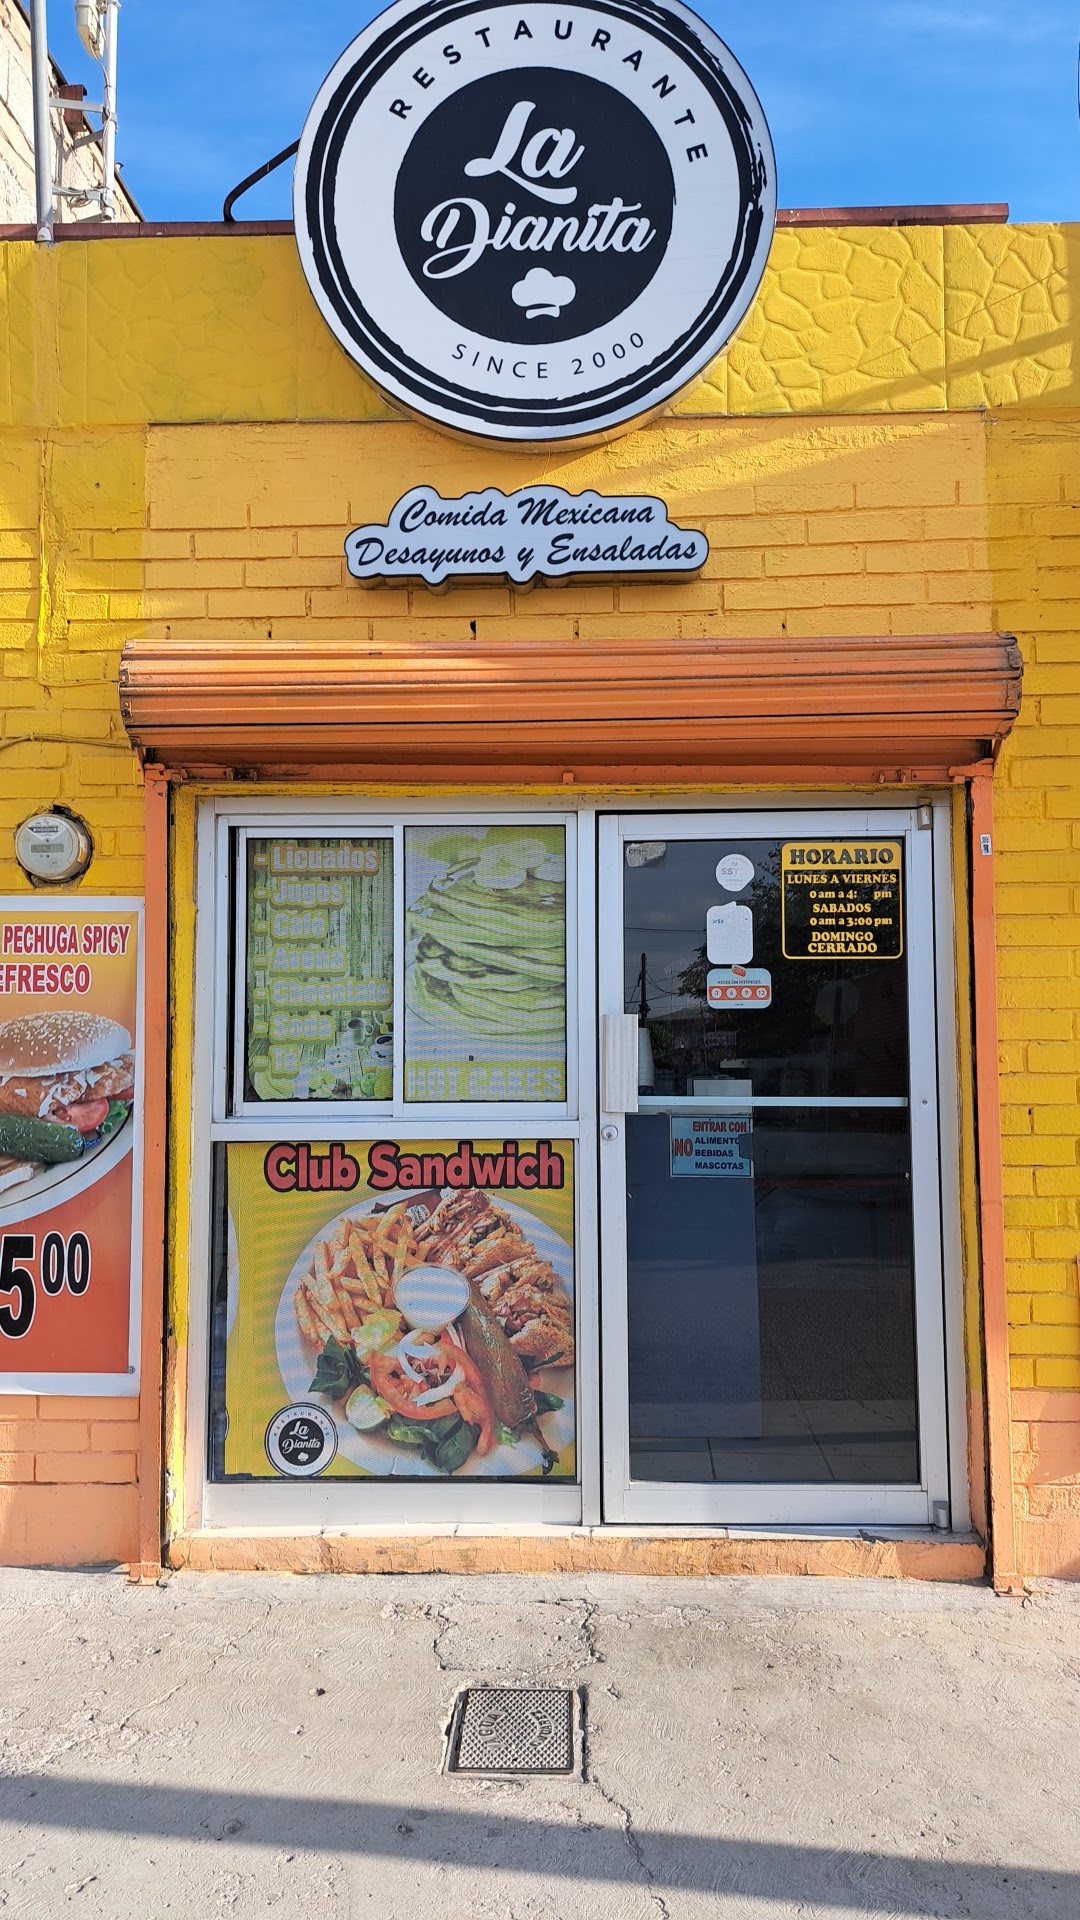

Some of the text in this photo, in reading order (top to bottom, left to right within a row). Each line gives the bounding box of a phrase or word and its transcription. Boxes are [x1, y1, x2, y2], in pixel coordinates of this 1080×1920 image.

[388, 19, 708, 163] RESTAURANTE
[464, 100, 585, 205] La
[420, 196, 657, 280] Dianita
[452, 332, 645, 380] SINCE 2000
[399, 498, 656, 533] Comida Mexicana
[355, 533, 698, 573] Desayunos y Ensaladas
[273, 846, 378, 870] Licuados
[789, 848, 894, 865] HORARIO
[787, 873, 897, 884] LUNES A VIERNES
[273, 880, 343, 906] Jugos
[838, 890, 845, 898] a
[873, 890, 893, 900] pm
[812, 903, 872, 913] SABADOS
[273, 912, 326, 937] Café
[838, 917, 846, 925] a
[846, 917, 873, 927] 3:00
[874, 917, 893, 927] pm
[3, 925, 131, 954] PECHUGA SPICY
[807, 942, 878, 953] CERRADO
[811, 931, 874, 942] DOMINGO
[272, 946, 345, 970] Avena
[0, 963, 91, 994] FRESCO
[273, 980, 390, 1004] Chocolate
[273, 1013, 332, 1038] Soda
[271, 1046, 298, 1073] Té
[407, 1066, 562, 1099] HOT CAKES
[692, 1121, 747, 1132] ENTRAR CON
[674, 1138, 693, 1157] NO
[694, 1136, 740, 1145] ALIMENTO
[694, 1149, 734, 1157] BEBIDAS
[264, 1140, 566, 1192] Club Sandwich
[694, 1161, 744, 1170] MASCOTAS
[289, 1420, 310, 1440] La
[282, 1437, 321, 1454] Dianita
